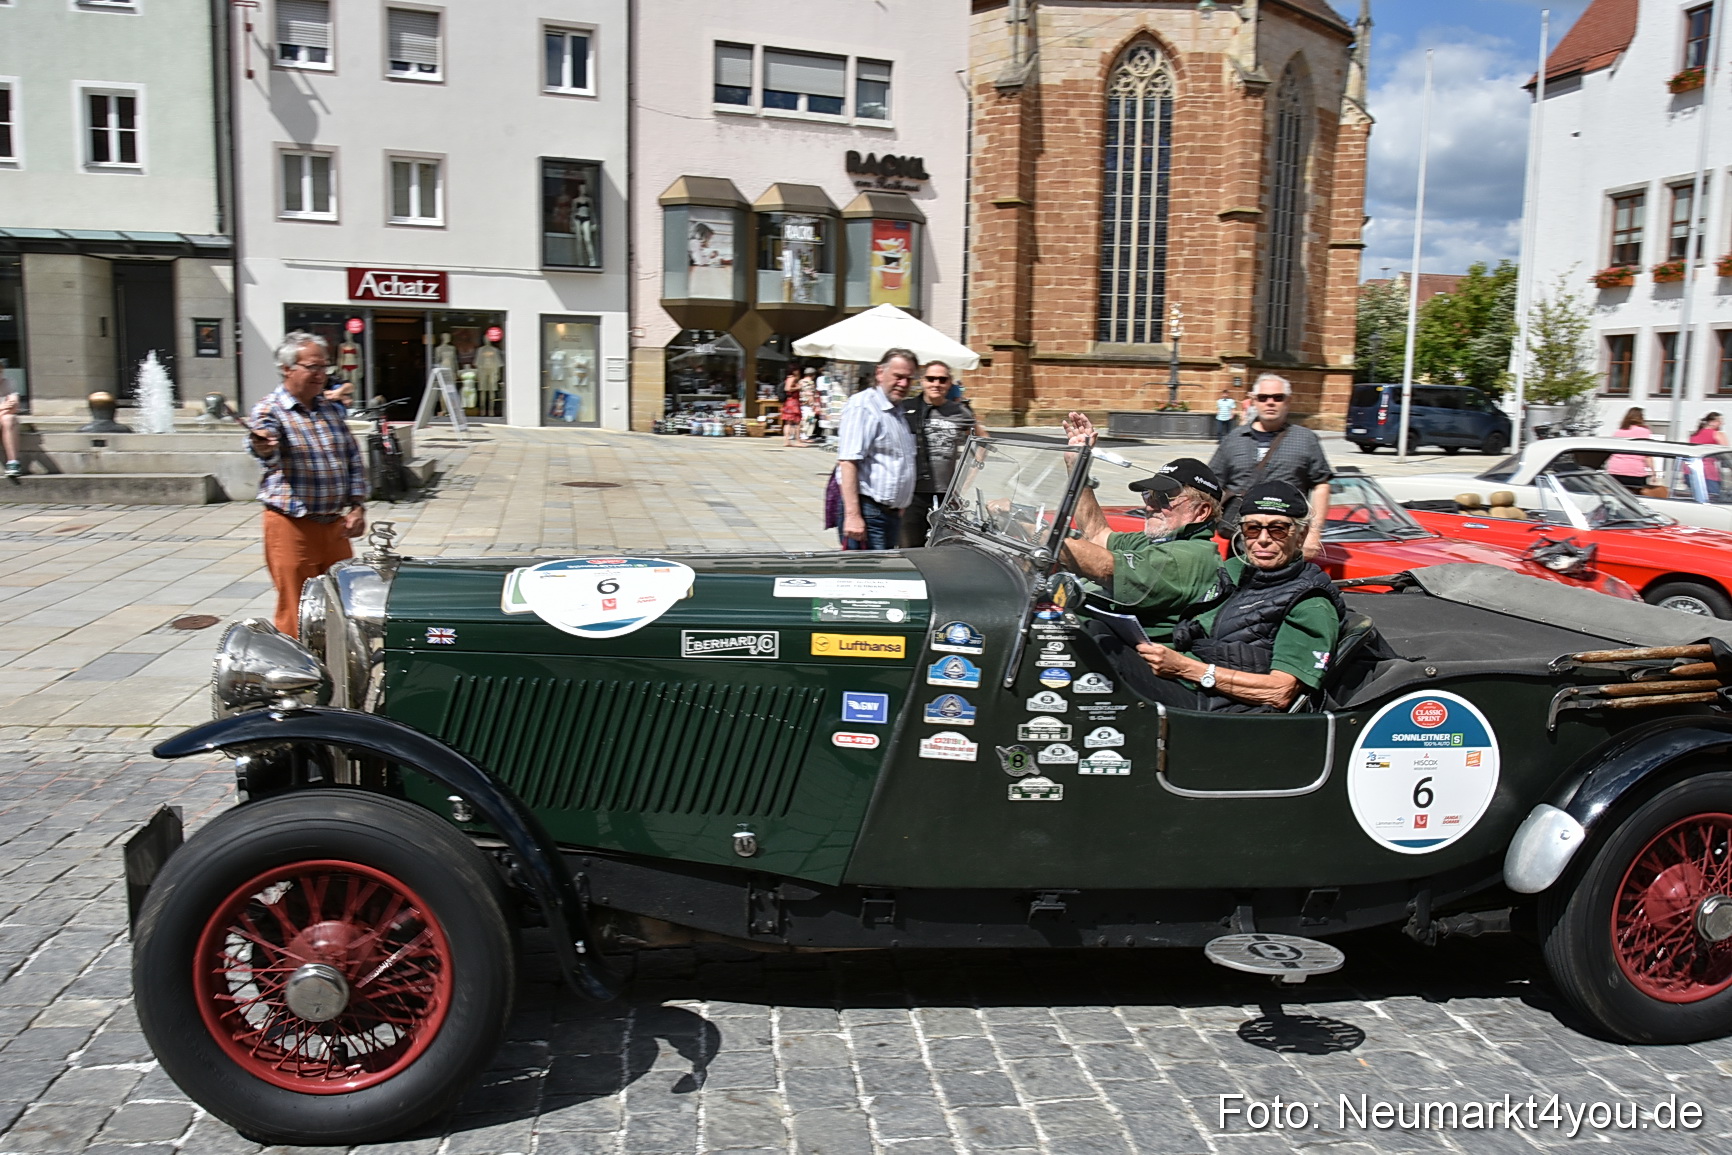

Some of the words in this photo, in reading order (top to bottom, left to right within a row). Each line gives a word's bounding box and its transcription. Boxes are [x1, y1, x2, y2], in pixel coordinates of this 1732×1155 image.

[354, 271, 441, 299] Achatz
[596, 577, 620, 595] 6
[685, 635, 757, 652] EBERHARD
[838, 639, 902, 652] Lufthansa
[1391, 733, 1451, 742] SONNLEITNER
[1011, 753, 1025, 768] 8
[1412, 776, 1434, 809] 6
